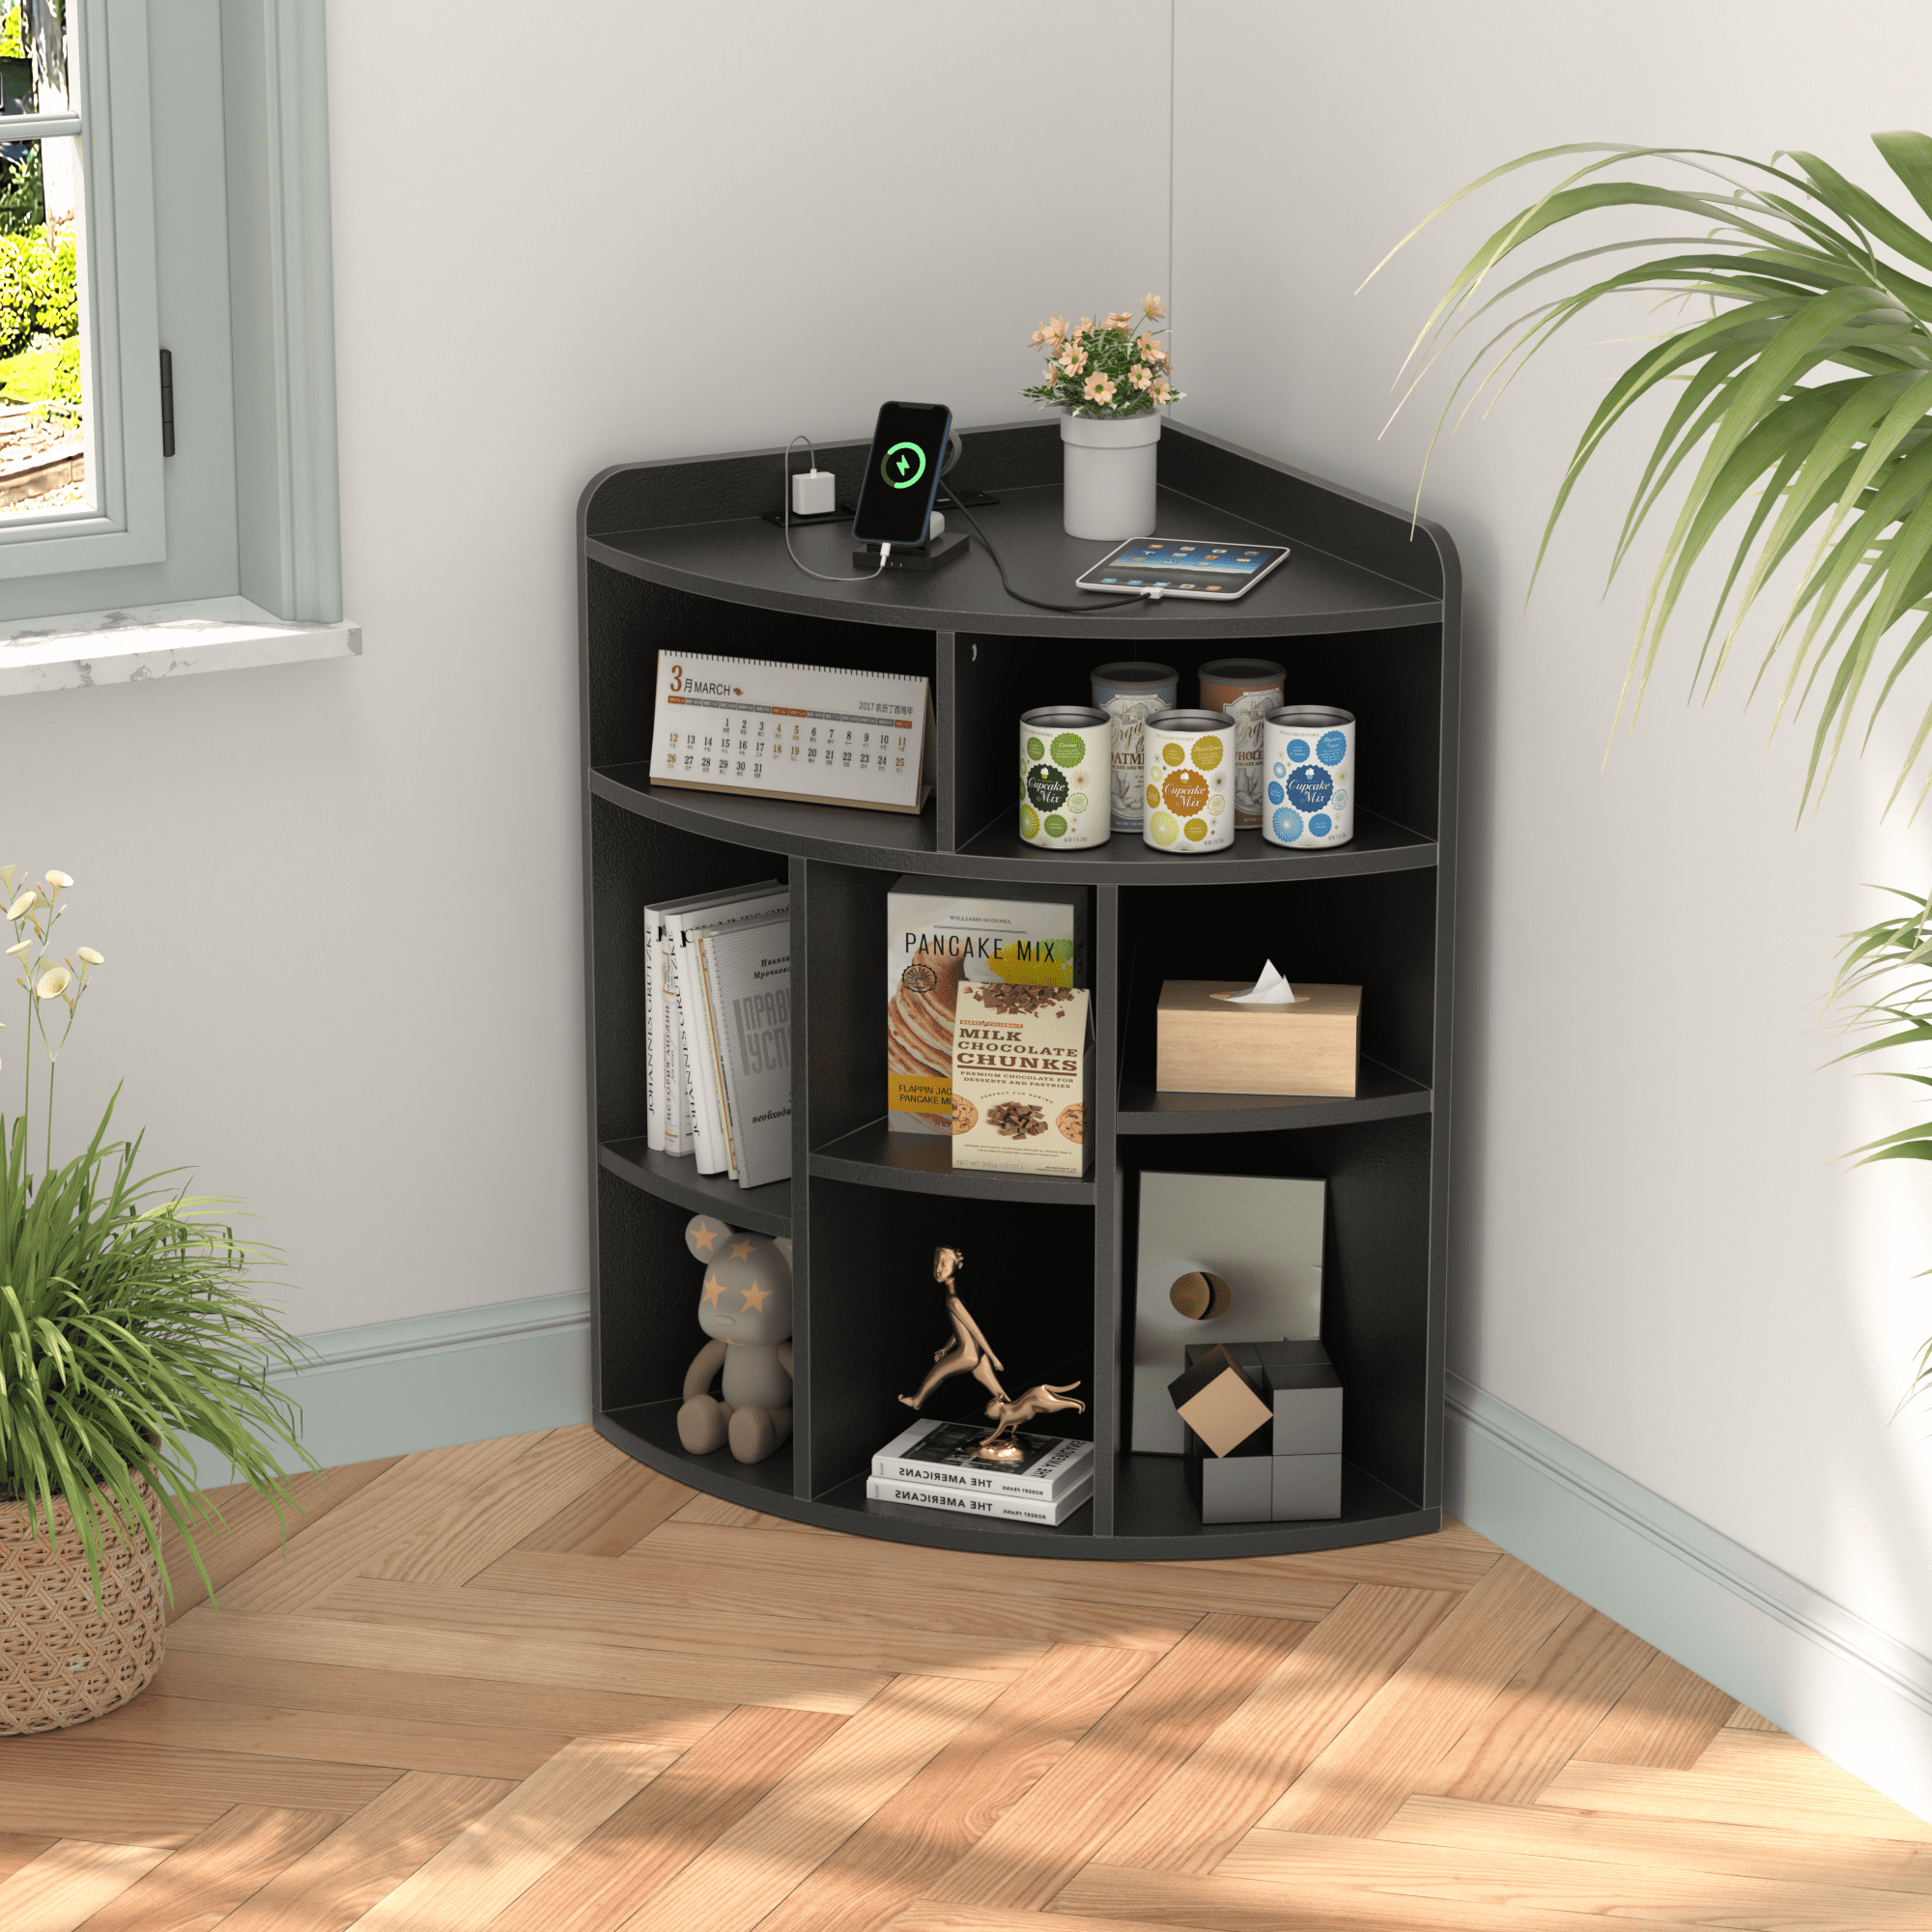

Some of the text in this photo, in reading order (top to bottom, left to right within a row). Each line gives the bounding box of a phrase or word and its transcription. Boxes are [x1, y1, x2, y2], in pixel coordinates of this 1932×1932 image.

[694, 682, 731, 696] MARCH
[859, 701, 874, 711] 2017
[725, 719, 906, 747] 1 2 3 4 5 6 7 8 9 10 11
[1111, 722, 1144, 752] Orga
[669, 733, 678, 743] 12
[687, 735, 696, 744] 13
[704, 737, 712, 746] 14
[722, 738, 730, 748] 15
[739, 741, 747, 750] 16
[755, 742, 764, 752] 17
[773, 744, 782, 753] 18
[790, 747, 800, 755] 19
[808, 748, 817, 757] 20
[825, 750, 834, 759] 21
[842, 752, 852, 761] 22
[860, 753, 869, 763] 23
[878, 755, 887, 765] 24
[895, 757, 905, 767] 25
[667, 753, 676, 763] 26
[684, 755, 694, 765] 27
[701, 757, 711, 767] 28
[719, 759, 728, 769] 29
[736, 761, 745, 771] 30
[753, 763, 762, 773] 31
[1028, 777, 1065, 791] Cupcake
[1165, 782, 1206, 797] Cupcake
[1289, 780, 1330, 793] Cupcake
[1037, 790, 1061, 803] Mix
[1176, 795, 1201, 808] Mix
[1300, 790, 1325, 803] Mix
[905, 932, 1055, 963] PANCAKE MIX
[761, 955, 790, 967] Никола
[753, 966, 790, 980] Мрочковс
[743, 988, 790, 1031] ПРАВ
[959, 1028, 1022, 1041] MILK
[747, 1027, 790, 1074] УСП
[957, 1040, 1078, 1057] CHOCOLATE
[956, 1052, 1077, 1071] CHUNKS
[681, 1031, 700, 1137] JOHANNES
[1003, 1073, 1055, 1082] CHOCOLATE
[898, 1084, 952, 1096] FLAPPIN JAC
[899, 1094, 938, 1104] PANCAKE
[753, 1107, 791, 1123] необходи
